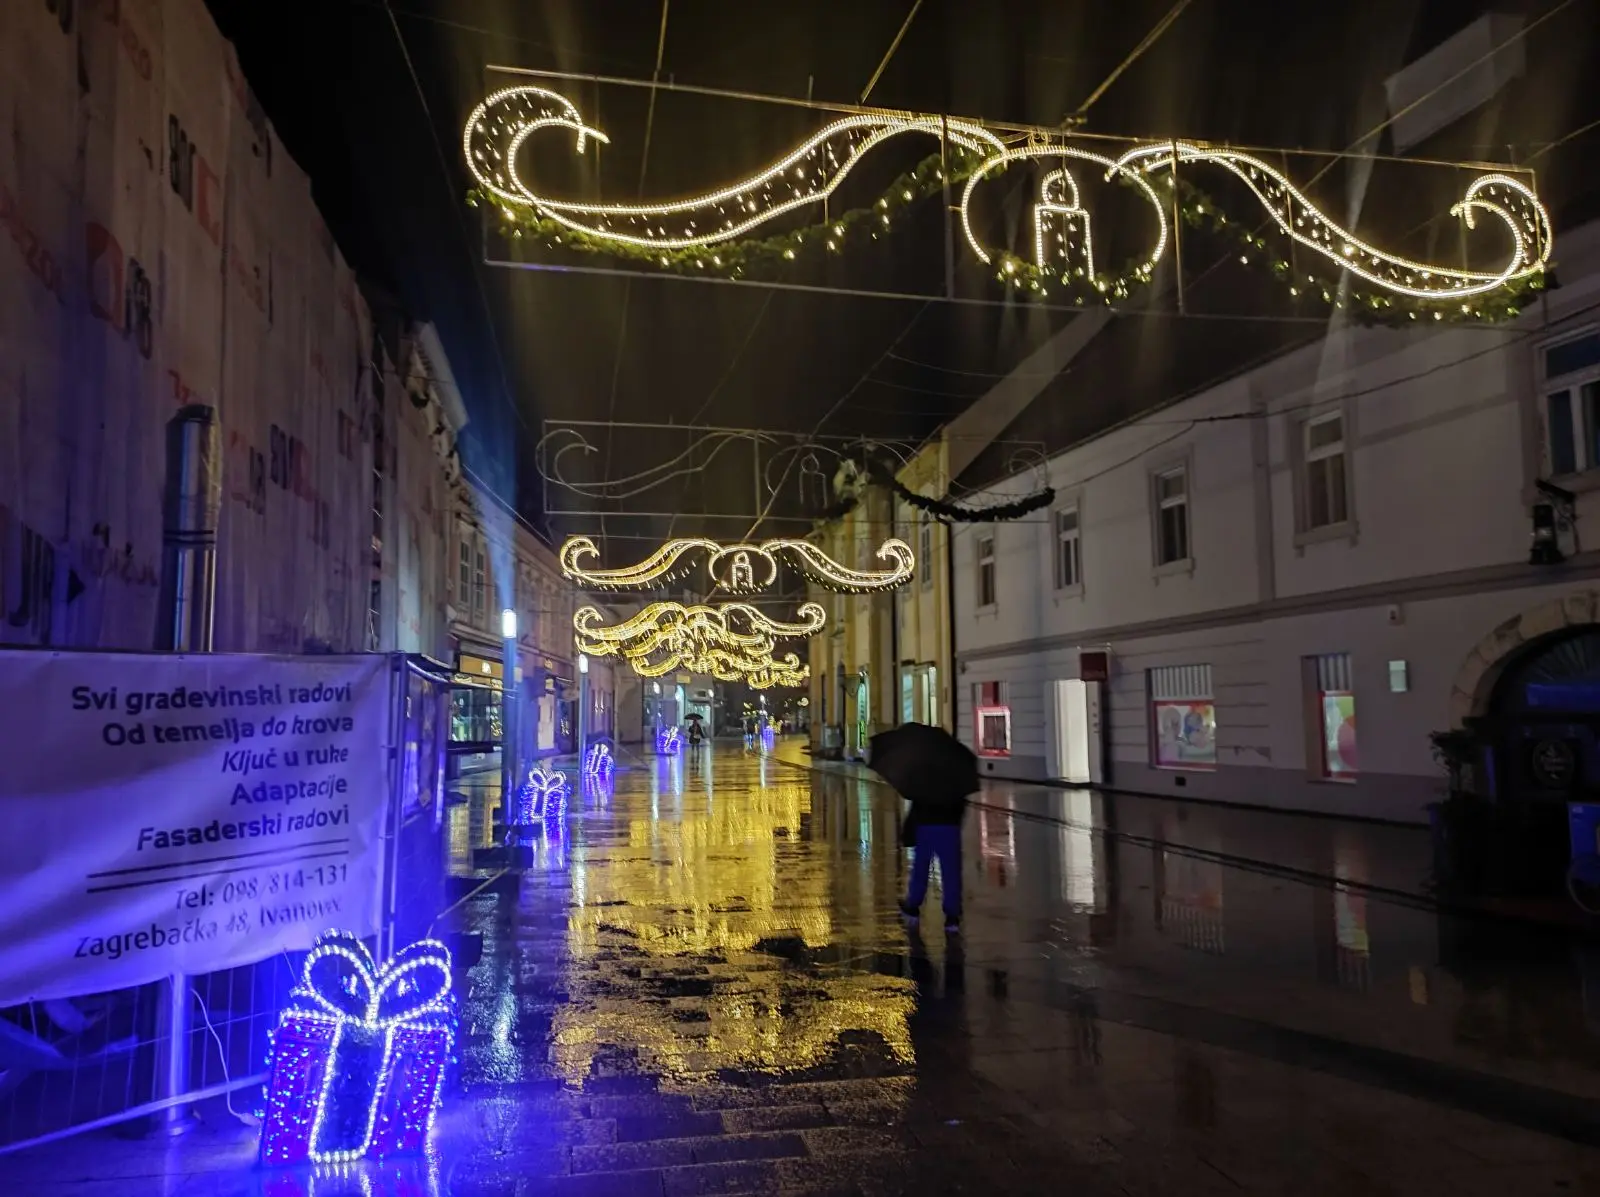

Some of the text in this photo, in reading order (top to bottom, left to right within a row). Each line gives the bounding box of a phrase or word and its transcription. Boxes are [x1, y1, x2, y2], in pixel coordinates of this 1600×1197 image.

[71, 681, 352, 715] Svi građevinski radovi
[102, 714, 354, 746] Od temelja do krova
[221, 744, 349, 775] Ključ u ruke
[230, 776, 348, 806] Adaptacije
[136, 804, 350, 851] Fasaderski radovi
[174, 884, 214, 910] Tel:
[74, 917, 218, 959] Zagrebačka
